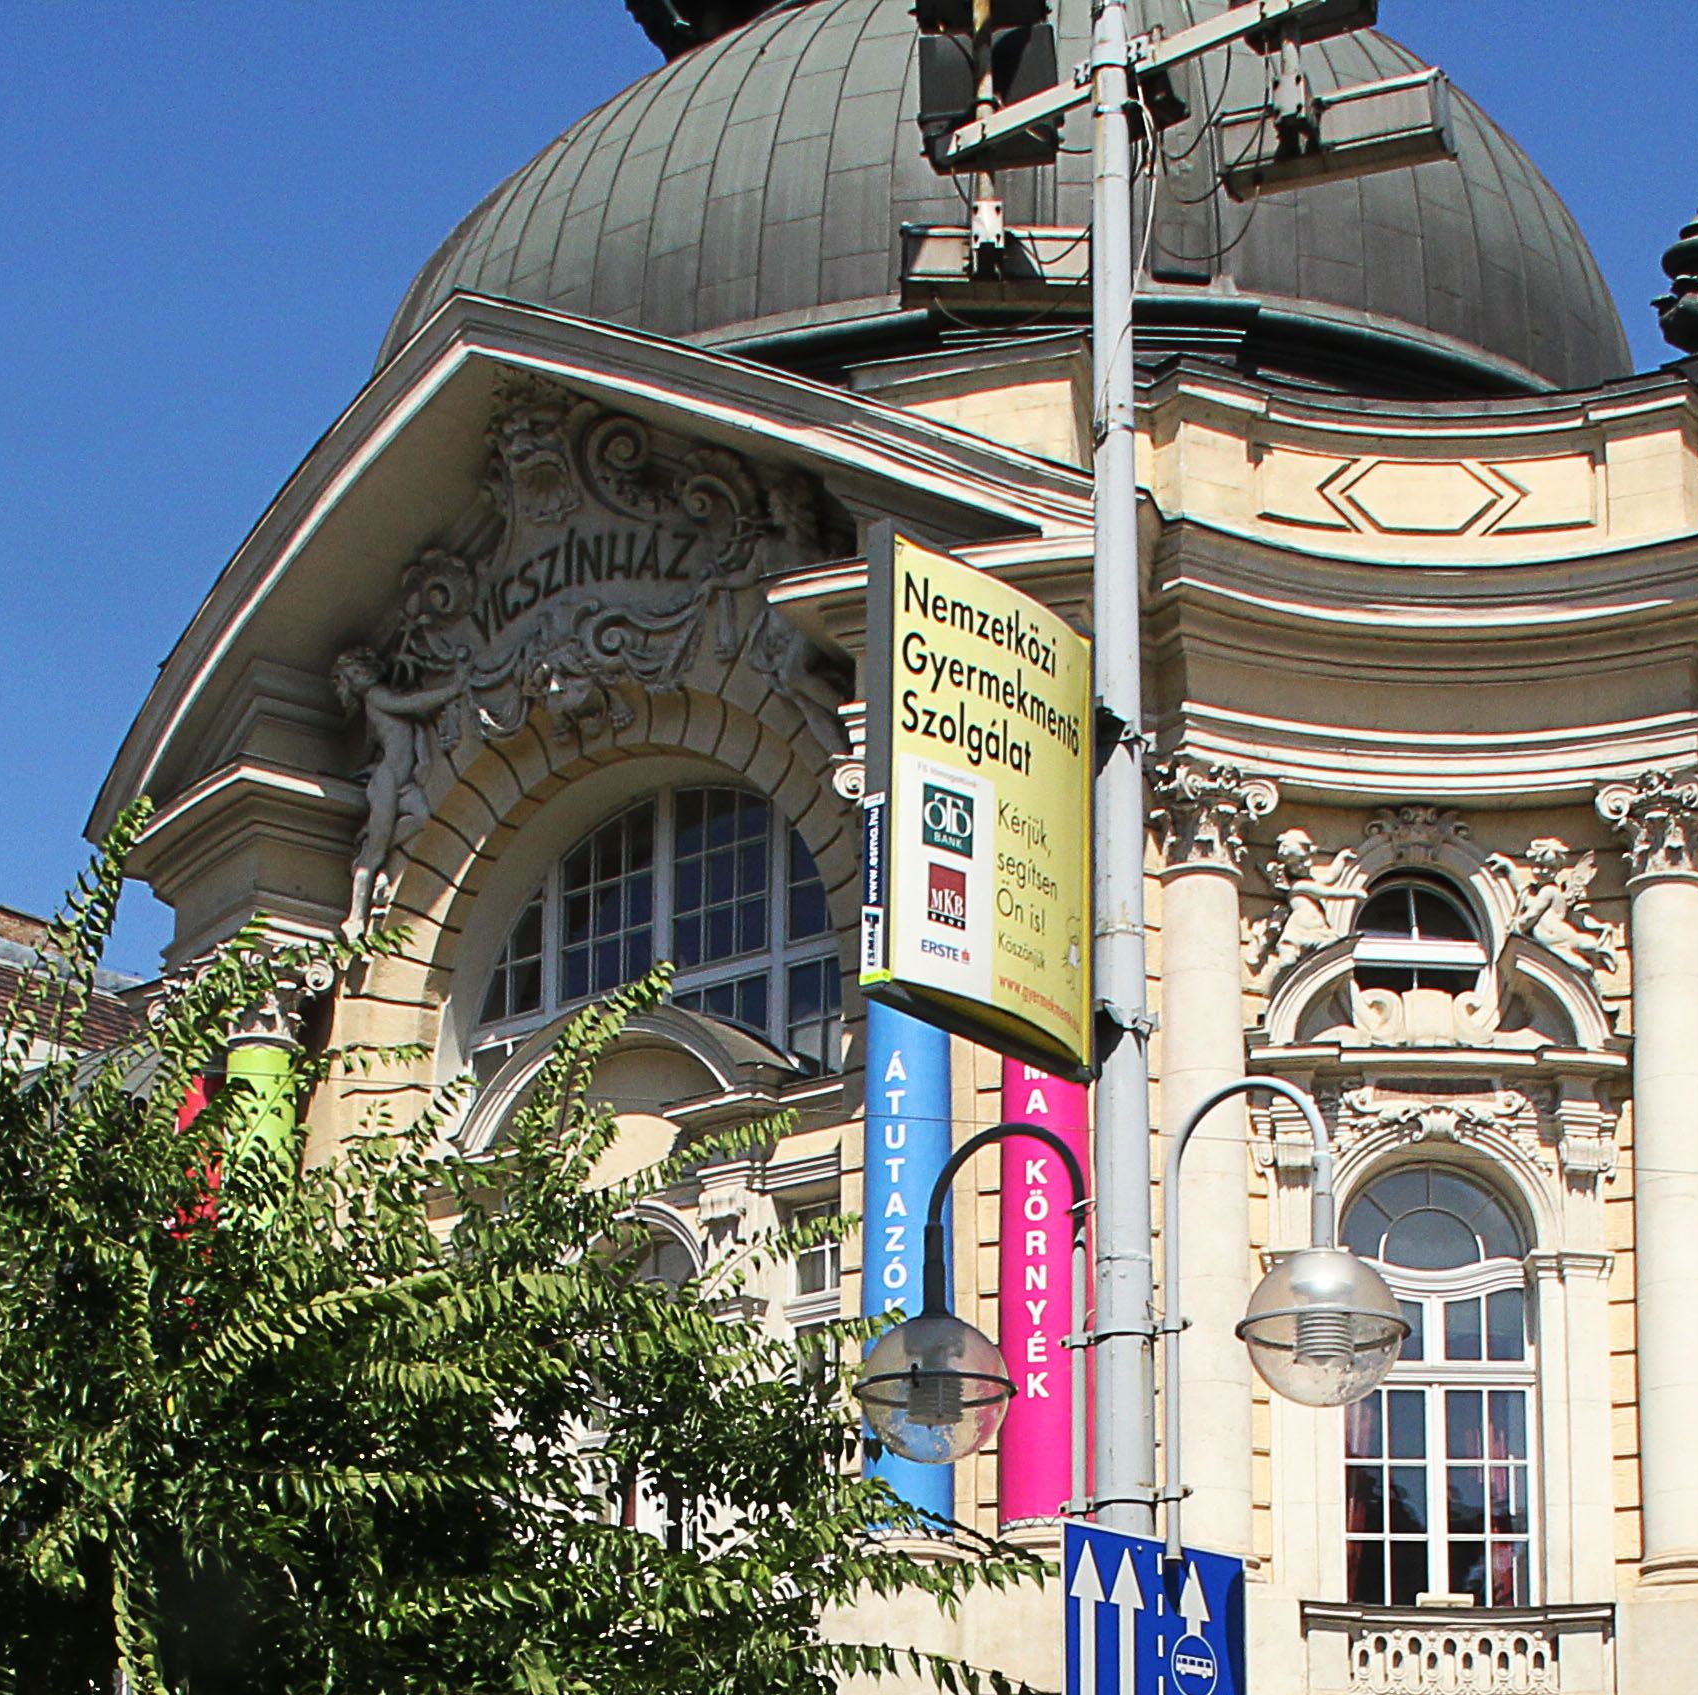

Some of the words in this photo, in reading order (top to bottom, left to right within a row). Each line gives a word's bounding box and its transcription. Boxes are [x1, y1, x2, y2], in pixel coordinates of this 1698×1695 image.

[904, 571, 1057, 679] Nemzetközi
[902, 632, 1079, 757] Gyermekmentő
[901, 690, 1032, 777] Szolgálat
[868, 807, 880, 904] www.esma.hu
[933, 831, 964, 850] BANK
[997, 799, 1052, 858] Kérjük,
[930, 888, 964, 917] MKB
[997, 851, 1058, 901] segítsen
[996, 880, 1024, 925] Ön
[1029, 903, 1046, 936] is!
[921, 938, 960, 963] ERSTE
[1024, 1159, 1050, 1399] KÖRNYÉK
